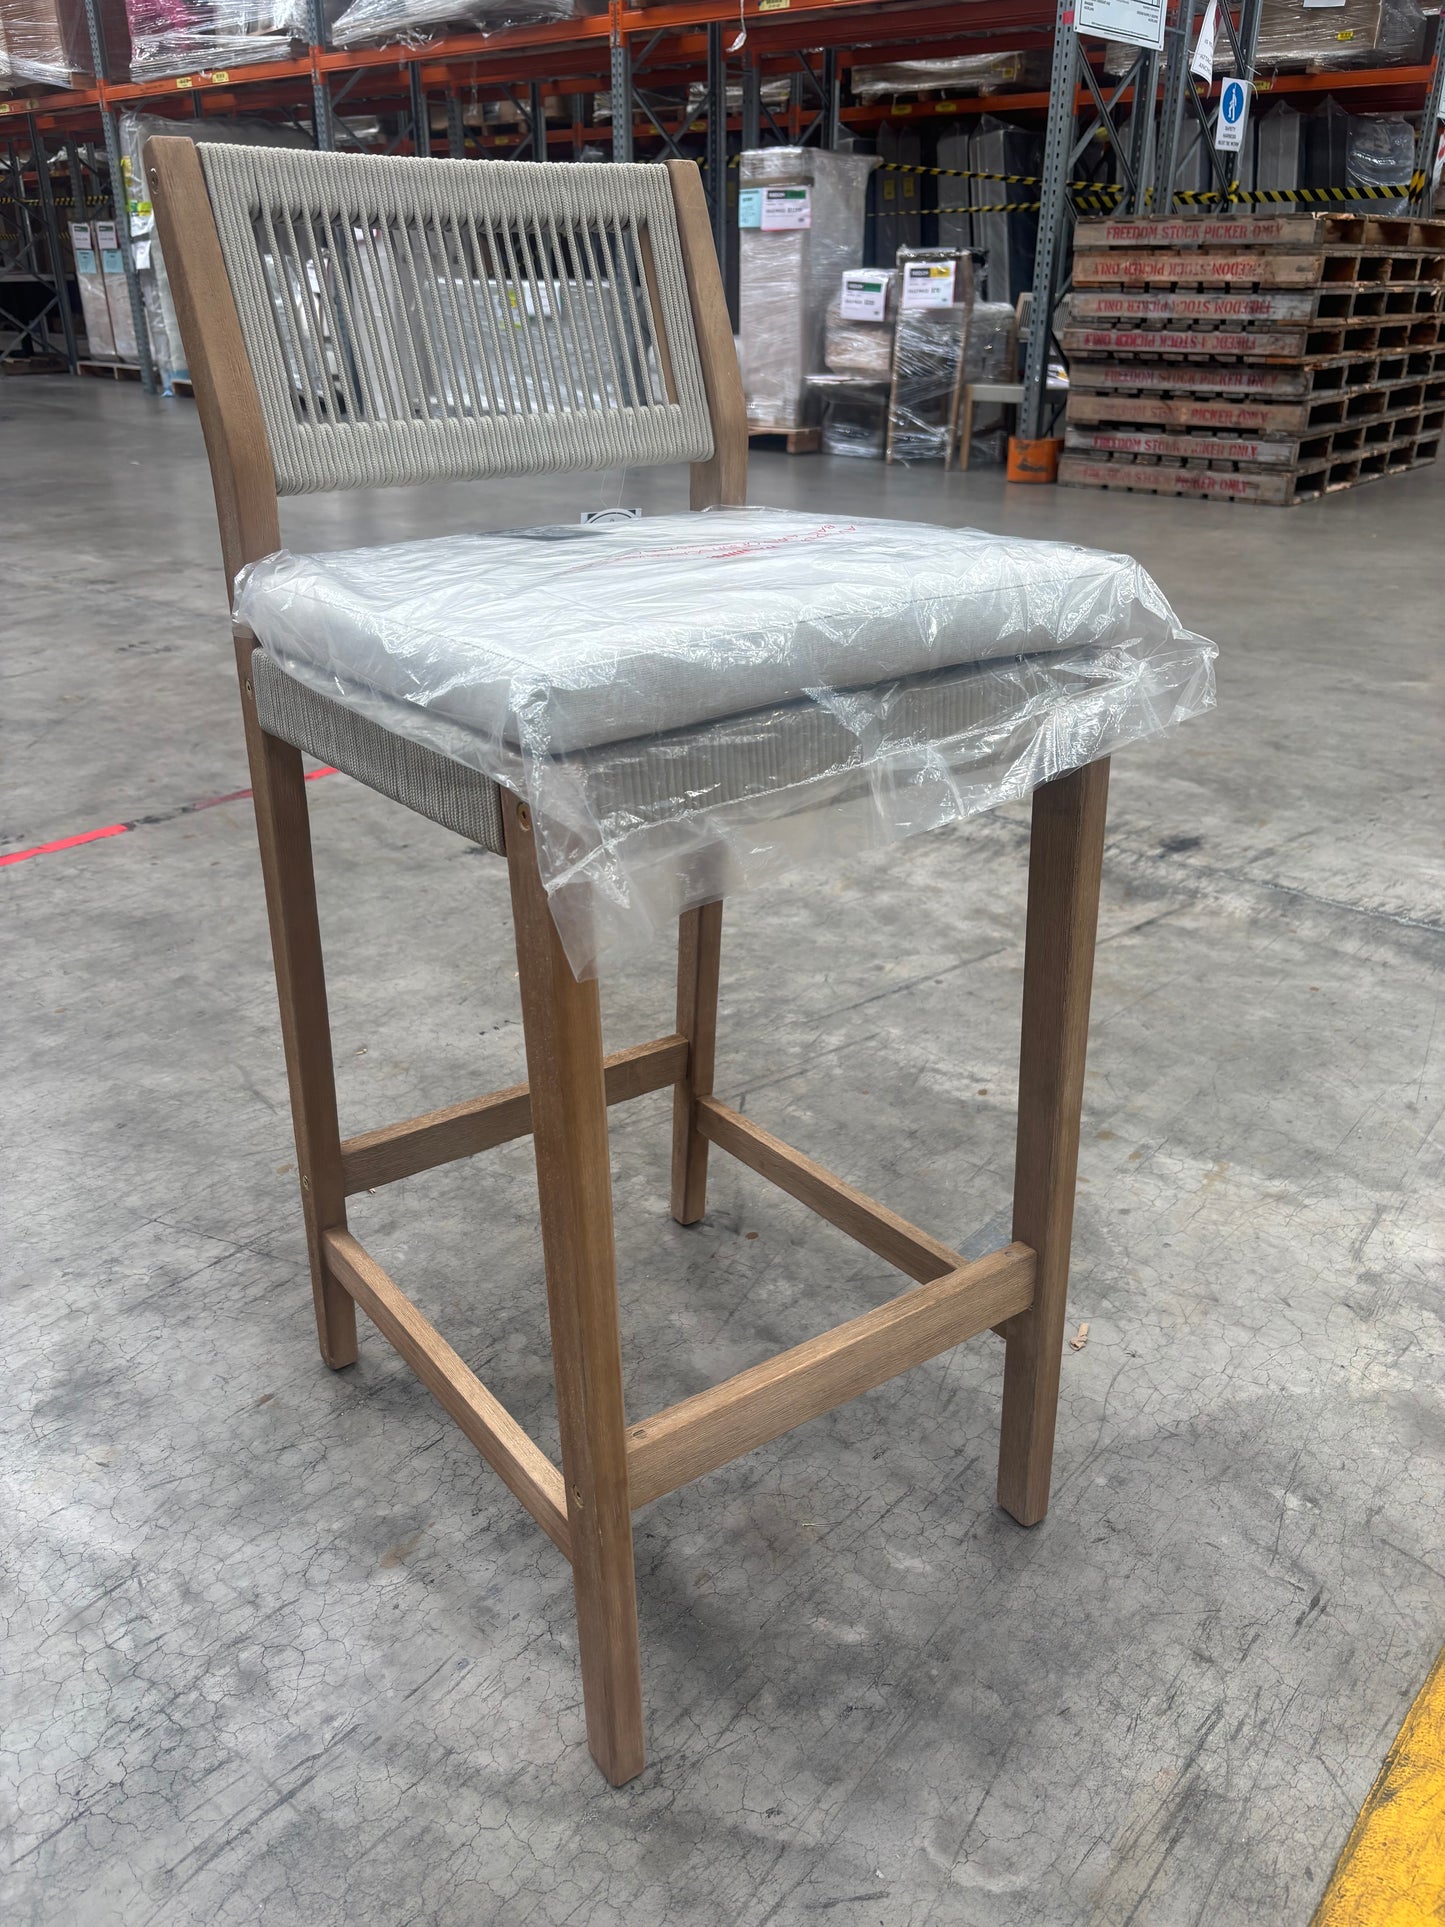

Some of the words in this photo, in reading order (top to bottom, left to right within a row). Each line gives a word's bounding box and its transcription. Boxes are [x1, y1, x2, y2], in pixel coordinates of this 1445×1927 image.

[1106, 224, 1157, 240] FREEDOM
[1161, 224, 1200, 239] STOCK
[1203, 224, 1248, 239] PICKER
[1093, 261, 1121, 276] ONLY
[1124, 261, 1165, 276] PICKER
[1211, 261, 1270, 278] EEDOM
[1095, 299, 1123, 313] ONLY
[1127, 299, 1169, 313] PICKER
[1213, 299, 1271, 315] FREEDOM
[1084, 333, 1112, 347] ONLY
[1115, 334, 1156, 348] PICKER
[1158, 335, 1198, 349] STOCK
[1191, 408, 1234, 424] PICKER
[1093, 436, 1142, 450] FREEDOM
[1184, 441, 1225, 456] CKER
[1229, 444, 1259, 459] ONLY
[1219, 477, 1249, 494] ONLY
